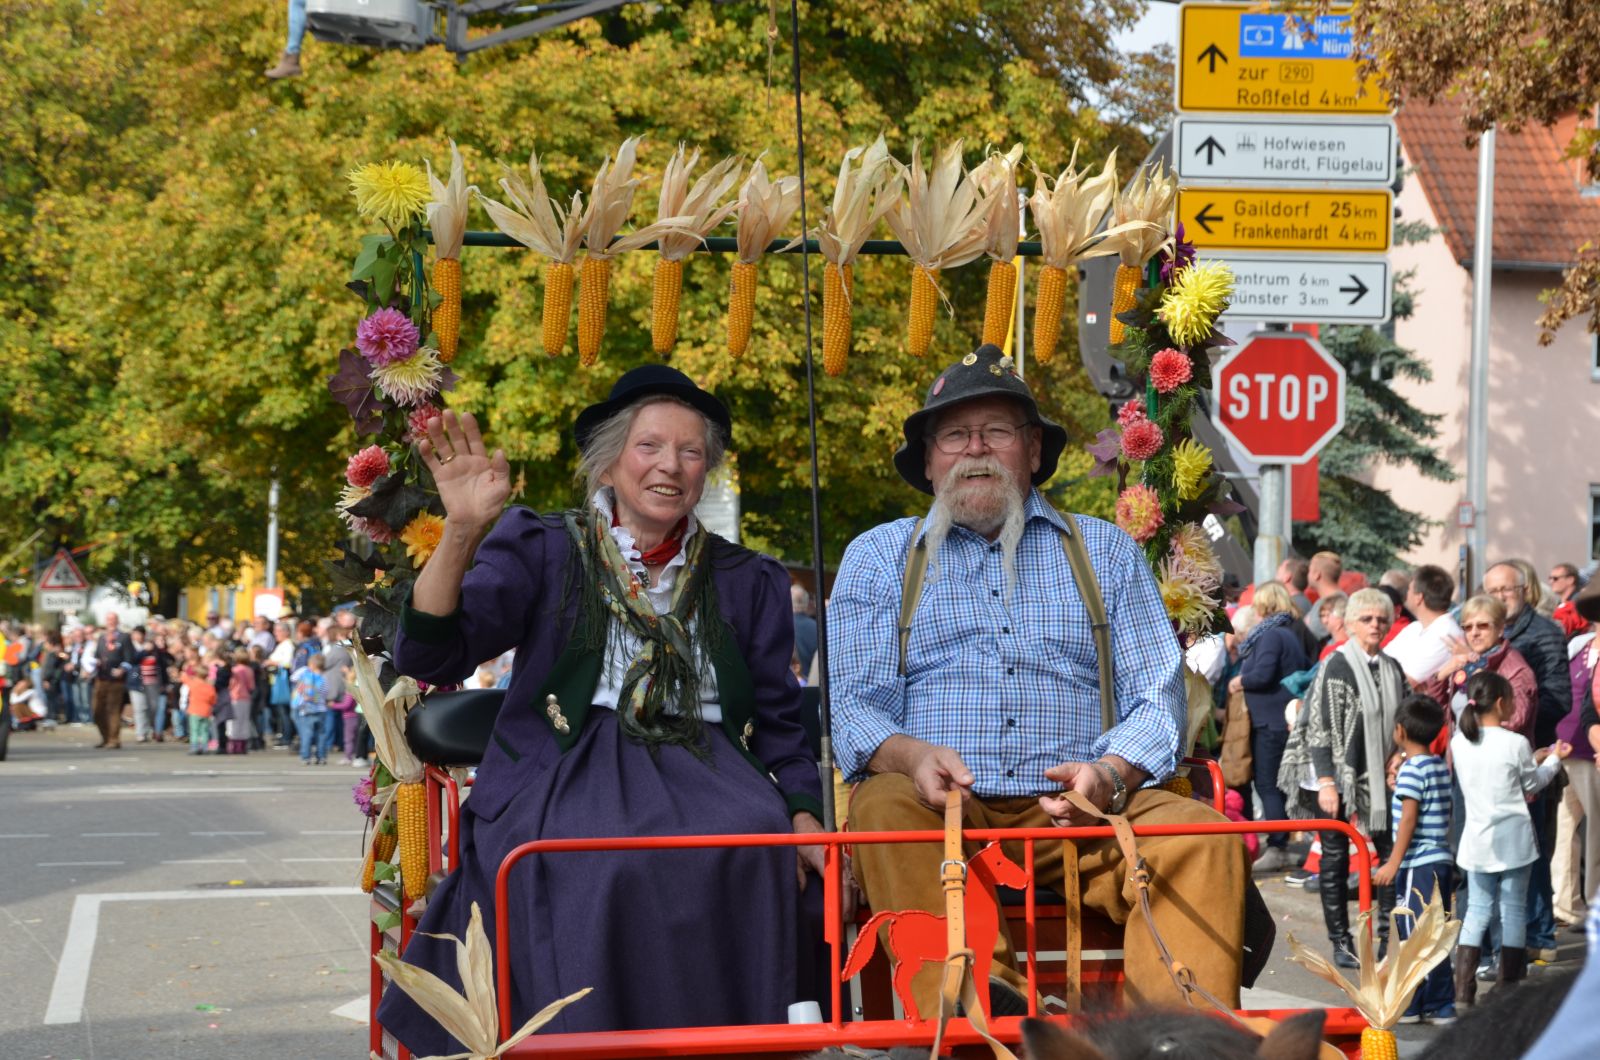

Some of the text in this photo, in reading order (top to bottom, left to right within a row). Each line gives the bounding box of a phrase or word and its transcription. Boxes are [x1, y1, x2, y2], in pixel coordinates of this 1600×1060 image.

[1238, 66, 1310, 81] zur 290
[1237, 88, 1358, 107] Roßfeld 4 km
[1263, 136, 1345, 151] Hofwiesen
[1263, 157, 1383, 175] Hardt, Flügelau
[1233, 200, 1378, 219] Gaildorf 25 km
[1233, 224, 1377, 241] Frankenhardt 4 km
[1232, 272, 1330, 287] entrum 6 km
[1299, 292, 1308, 305] 3
[1311, 296, 1329, 306] km
[1228, 373, 1329, 421] STOP
